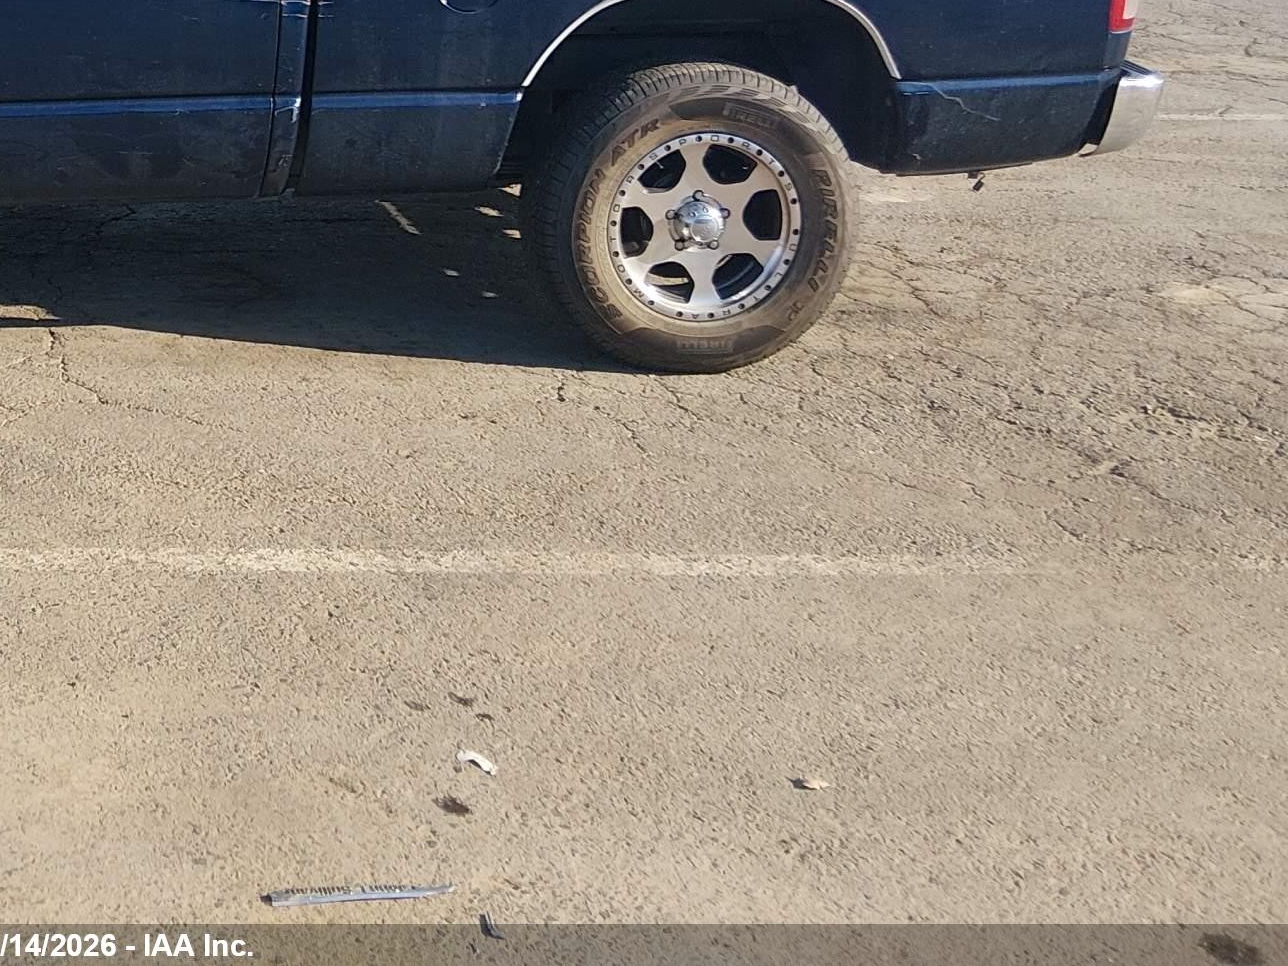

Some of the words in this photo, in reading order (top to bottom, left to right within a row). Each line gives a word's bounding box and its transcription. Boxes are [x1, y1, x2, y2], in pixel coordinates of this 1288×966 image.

[575, 168, 624, 320] SCORPION
[611, 118, 661, 166] ATR
[609, 135, 794, 300] MOTORSPORTS
[691, 244, 797, 320] ULTRA
